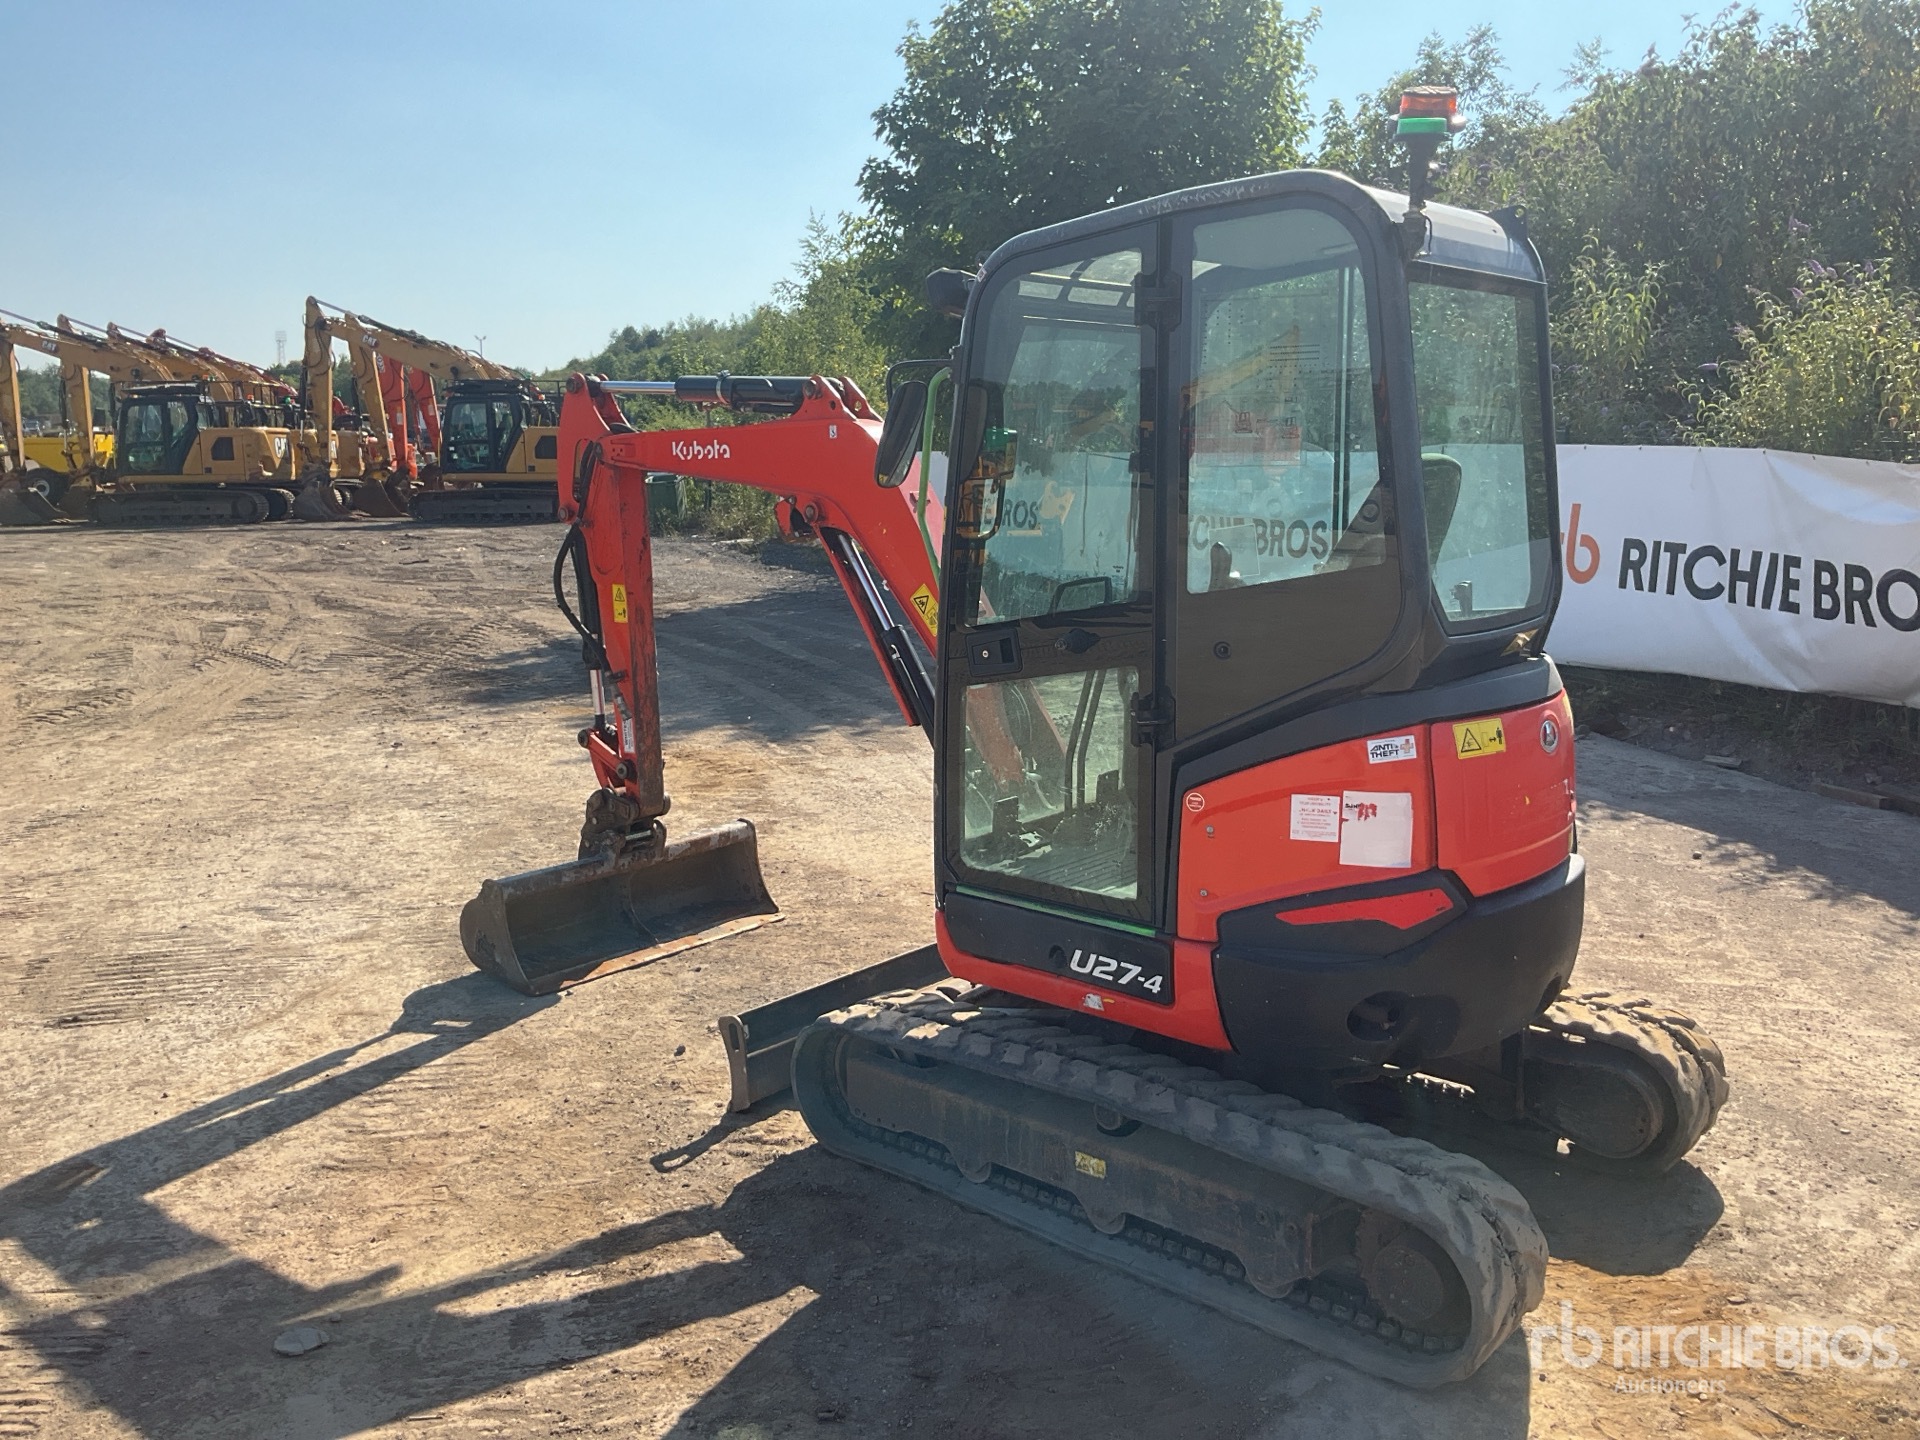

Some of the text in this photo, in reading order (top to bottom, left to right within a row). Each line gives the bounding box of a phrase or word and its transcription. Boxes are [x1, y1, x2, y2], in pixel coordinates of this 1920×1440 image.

[361, 334, 378, 347] CAT
[672, 439, 730, 460] Kubota
[1618, 537, 1802, 614] RITCHIE
[1370, 743, 1393, 752] ANTI
[1370, 749, 1399, 758] THEFT
[1069, 949, 1163, 994] U27-4
